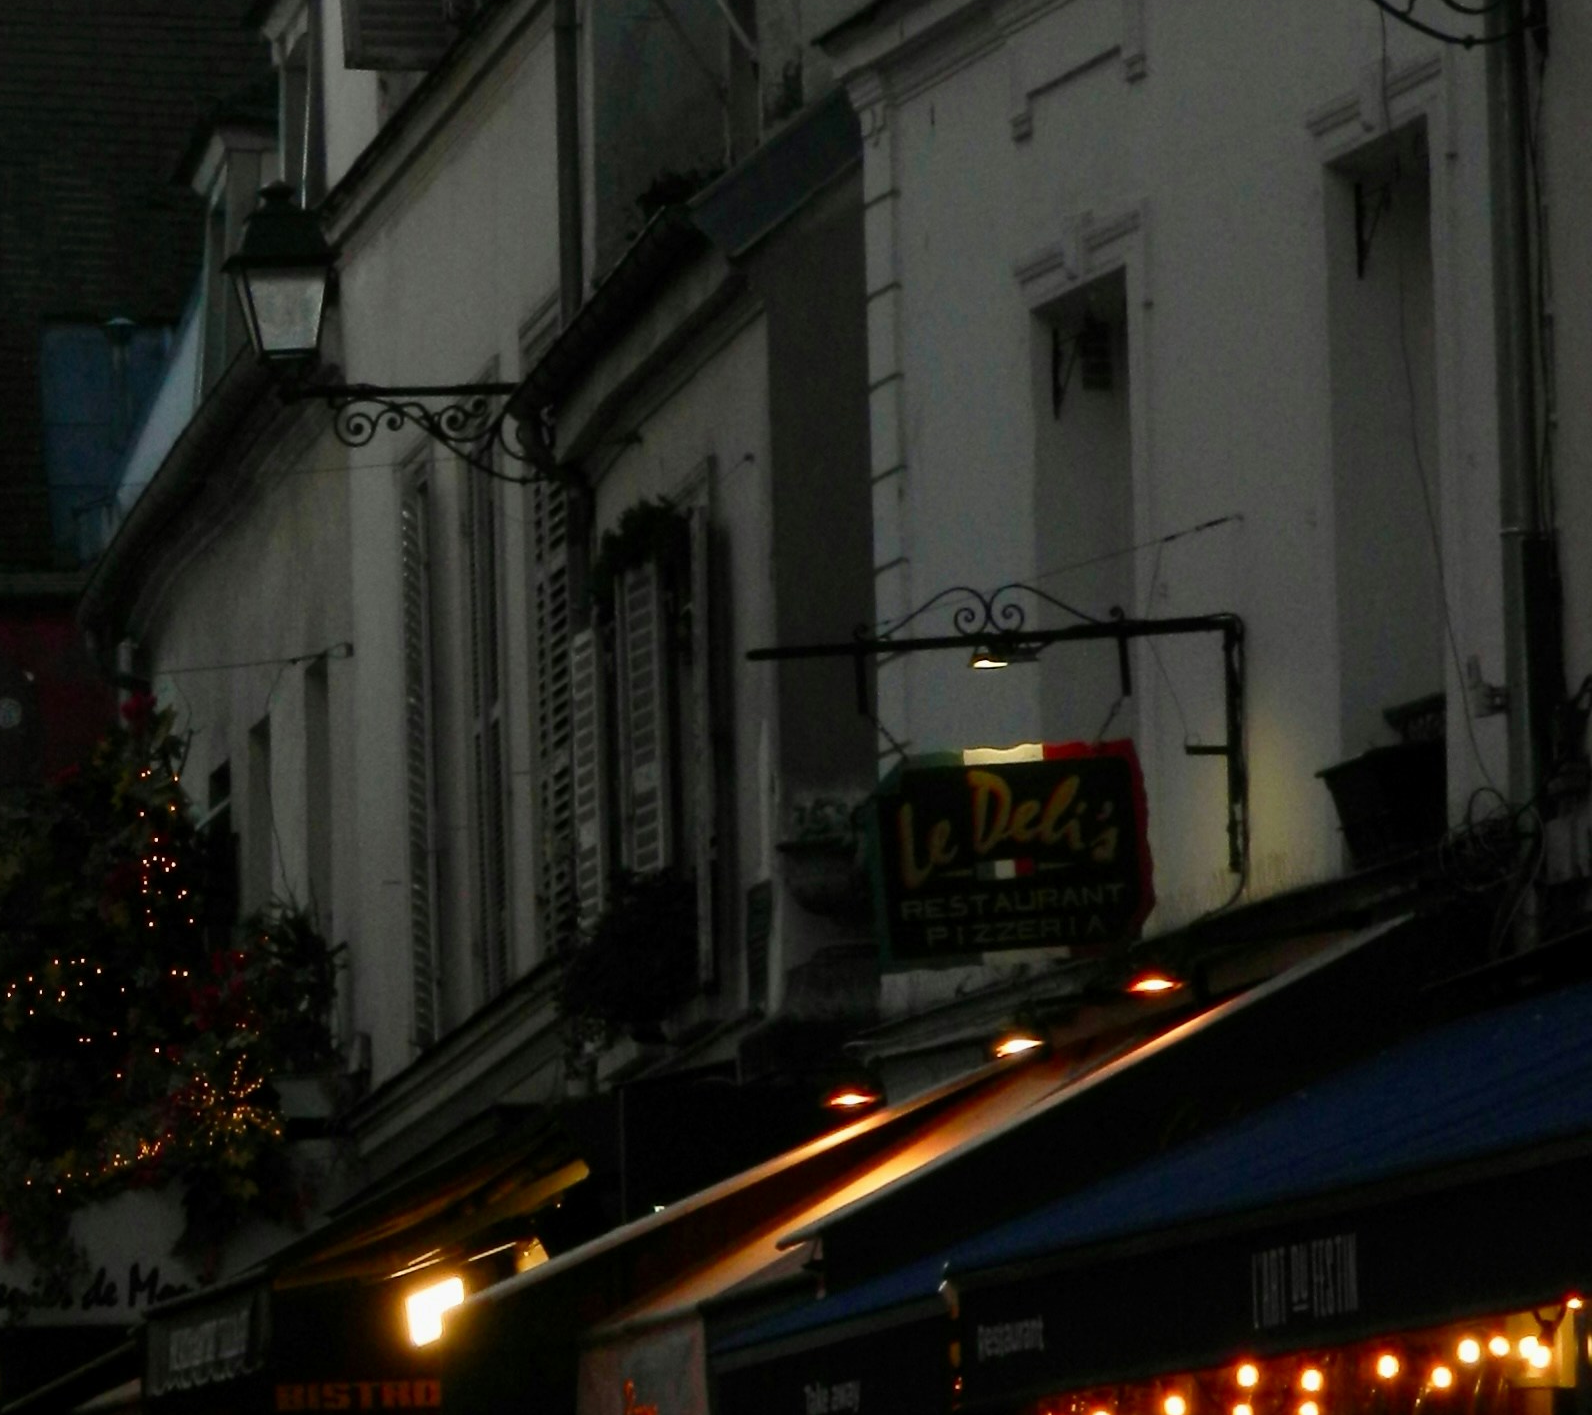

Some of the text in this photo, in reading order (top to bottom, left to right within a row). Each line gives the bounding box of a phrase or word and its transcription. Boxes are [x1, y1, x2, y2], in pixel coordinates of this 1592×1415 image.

[895, 800, 959, 890] Le
[899, 882, 1128, 921] RESTAURANT
[926, 913, 1110, 948] PIZZERIA
[82, 1266, 119, 1311] de
[274, 1377, 442, 1413] BISTRO
